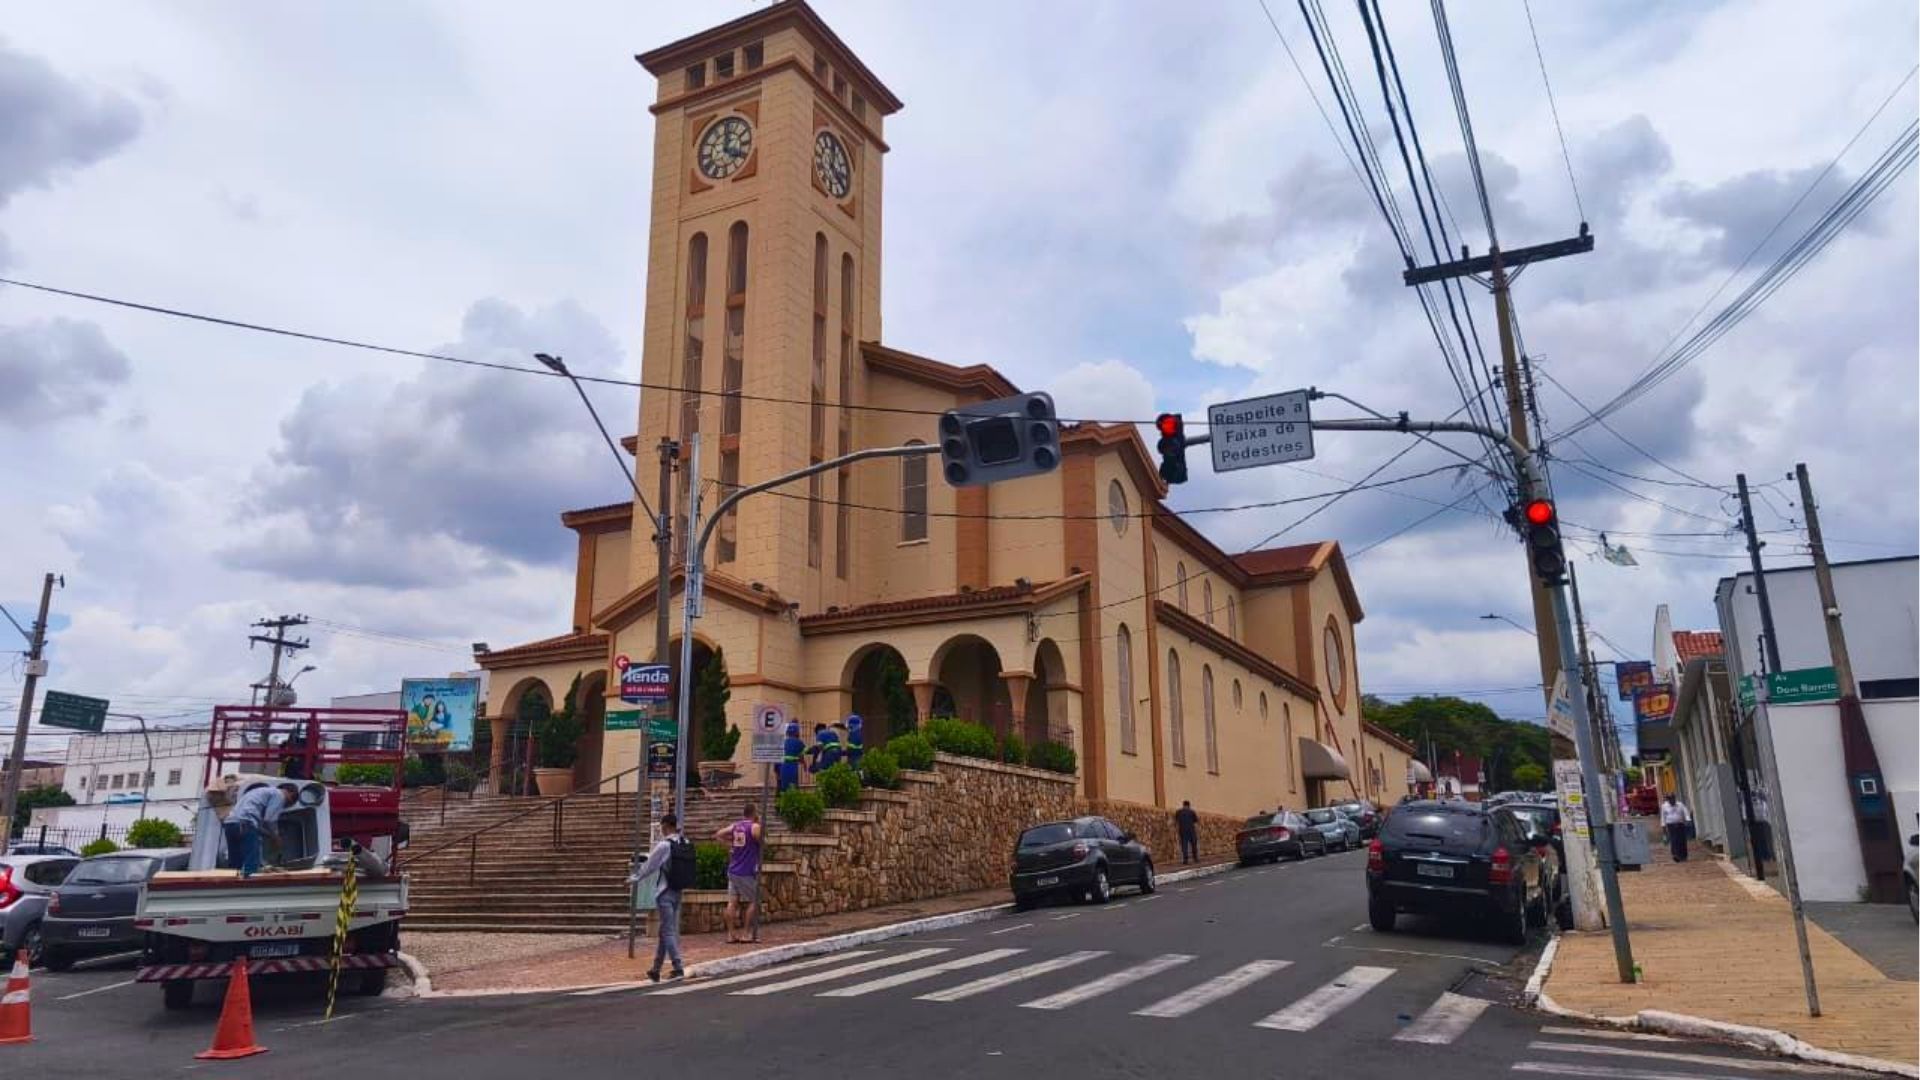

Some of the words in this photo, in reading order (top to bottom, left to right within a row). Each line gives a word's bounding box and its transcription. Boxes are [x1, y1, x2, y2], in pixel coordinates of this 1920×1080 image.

[1215, 405, 1285, 425] Respeite
[1226, 428, 1267, 444] Faixa
[1275, 422, 1295, 434] de
[1222, 442, 1304, 462] Pedestres
[1776, 686, 1799, 694] Dom
[1801, 683, 1839, 693] Barreto
[765, 712, 776, 728] E
